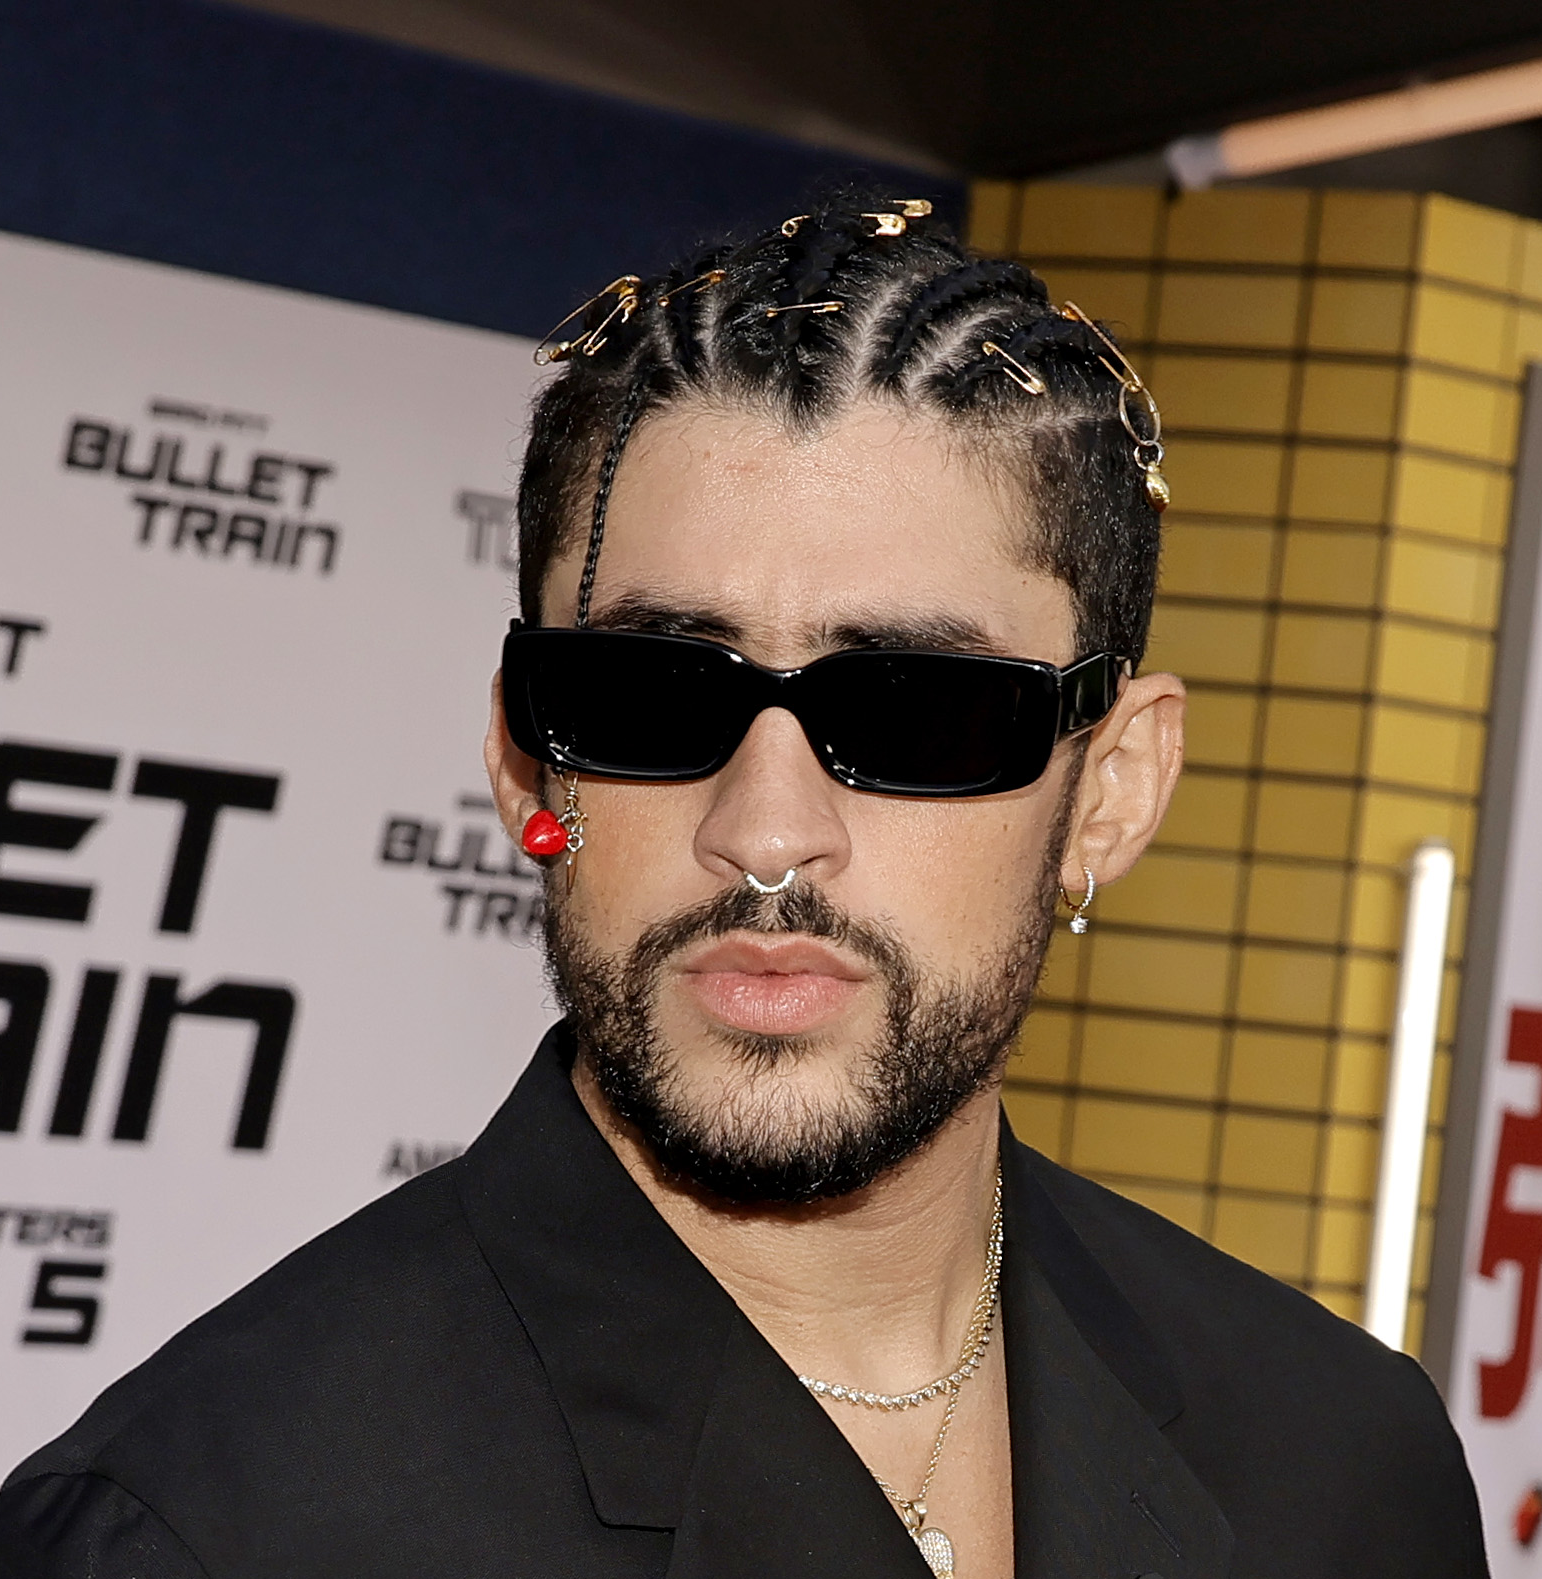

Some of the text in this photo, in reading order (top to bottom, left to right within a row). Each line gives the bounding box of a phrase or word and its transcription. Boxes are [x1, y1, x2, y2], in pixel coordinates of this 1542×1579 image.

[62, 418, 334, 511] BULLET
[131, 492, 339, 574] TRAIN
[19, 1257, 109, 1348] 5
